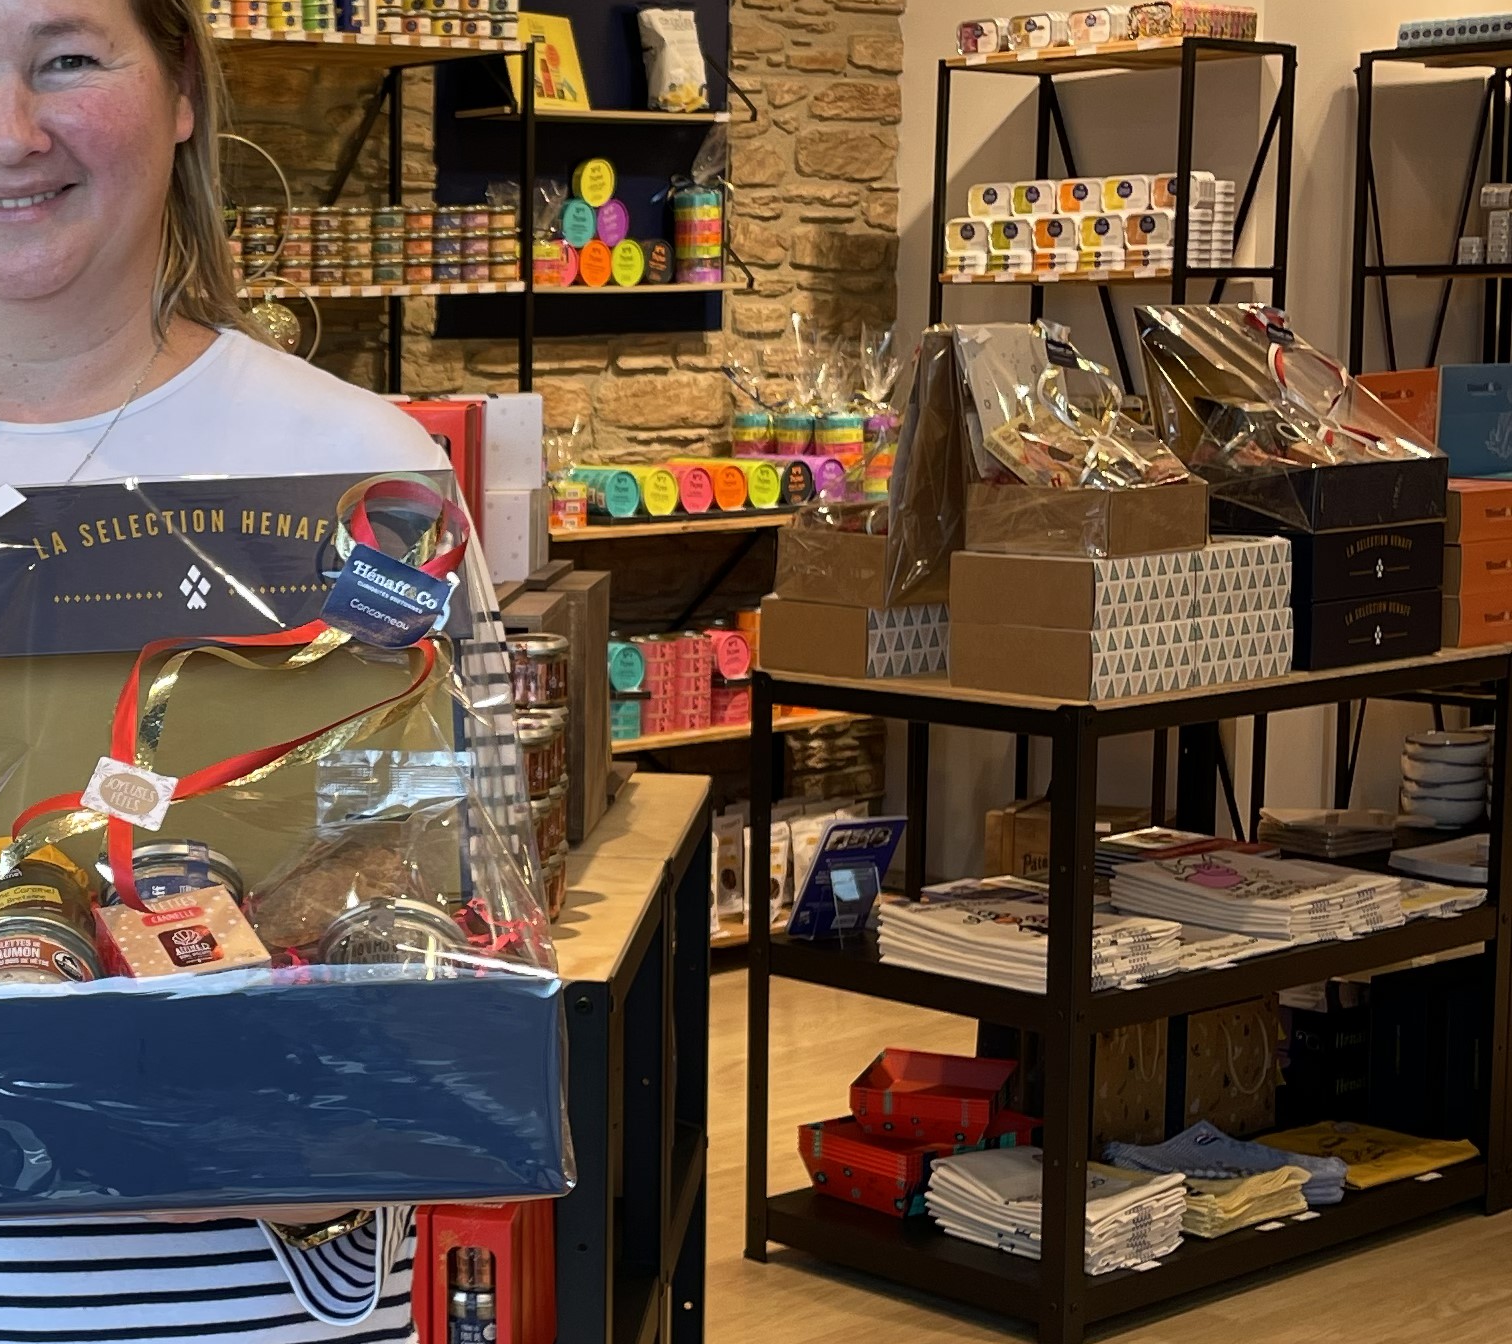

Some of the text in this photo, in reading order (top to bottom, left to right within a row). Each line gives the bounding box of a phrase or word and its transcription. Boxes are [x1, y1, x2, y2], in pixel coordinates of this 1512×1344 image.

[32, 508, 337, 561] LA SELECTION HENAF
[349, 598, 410, 631] Concarneau
[105, 777, 157, 803] JOYEUSES
[13, 885, 56, 896] Caramel
[146, 895, 198, 913] LETTES
